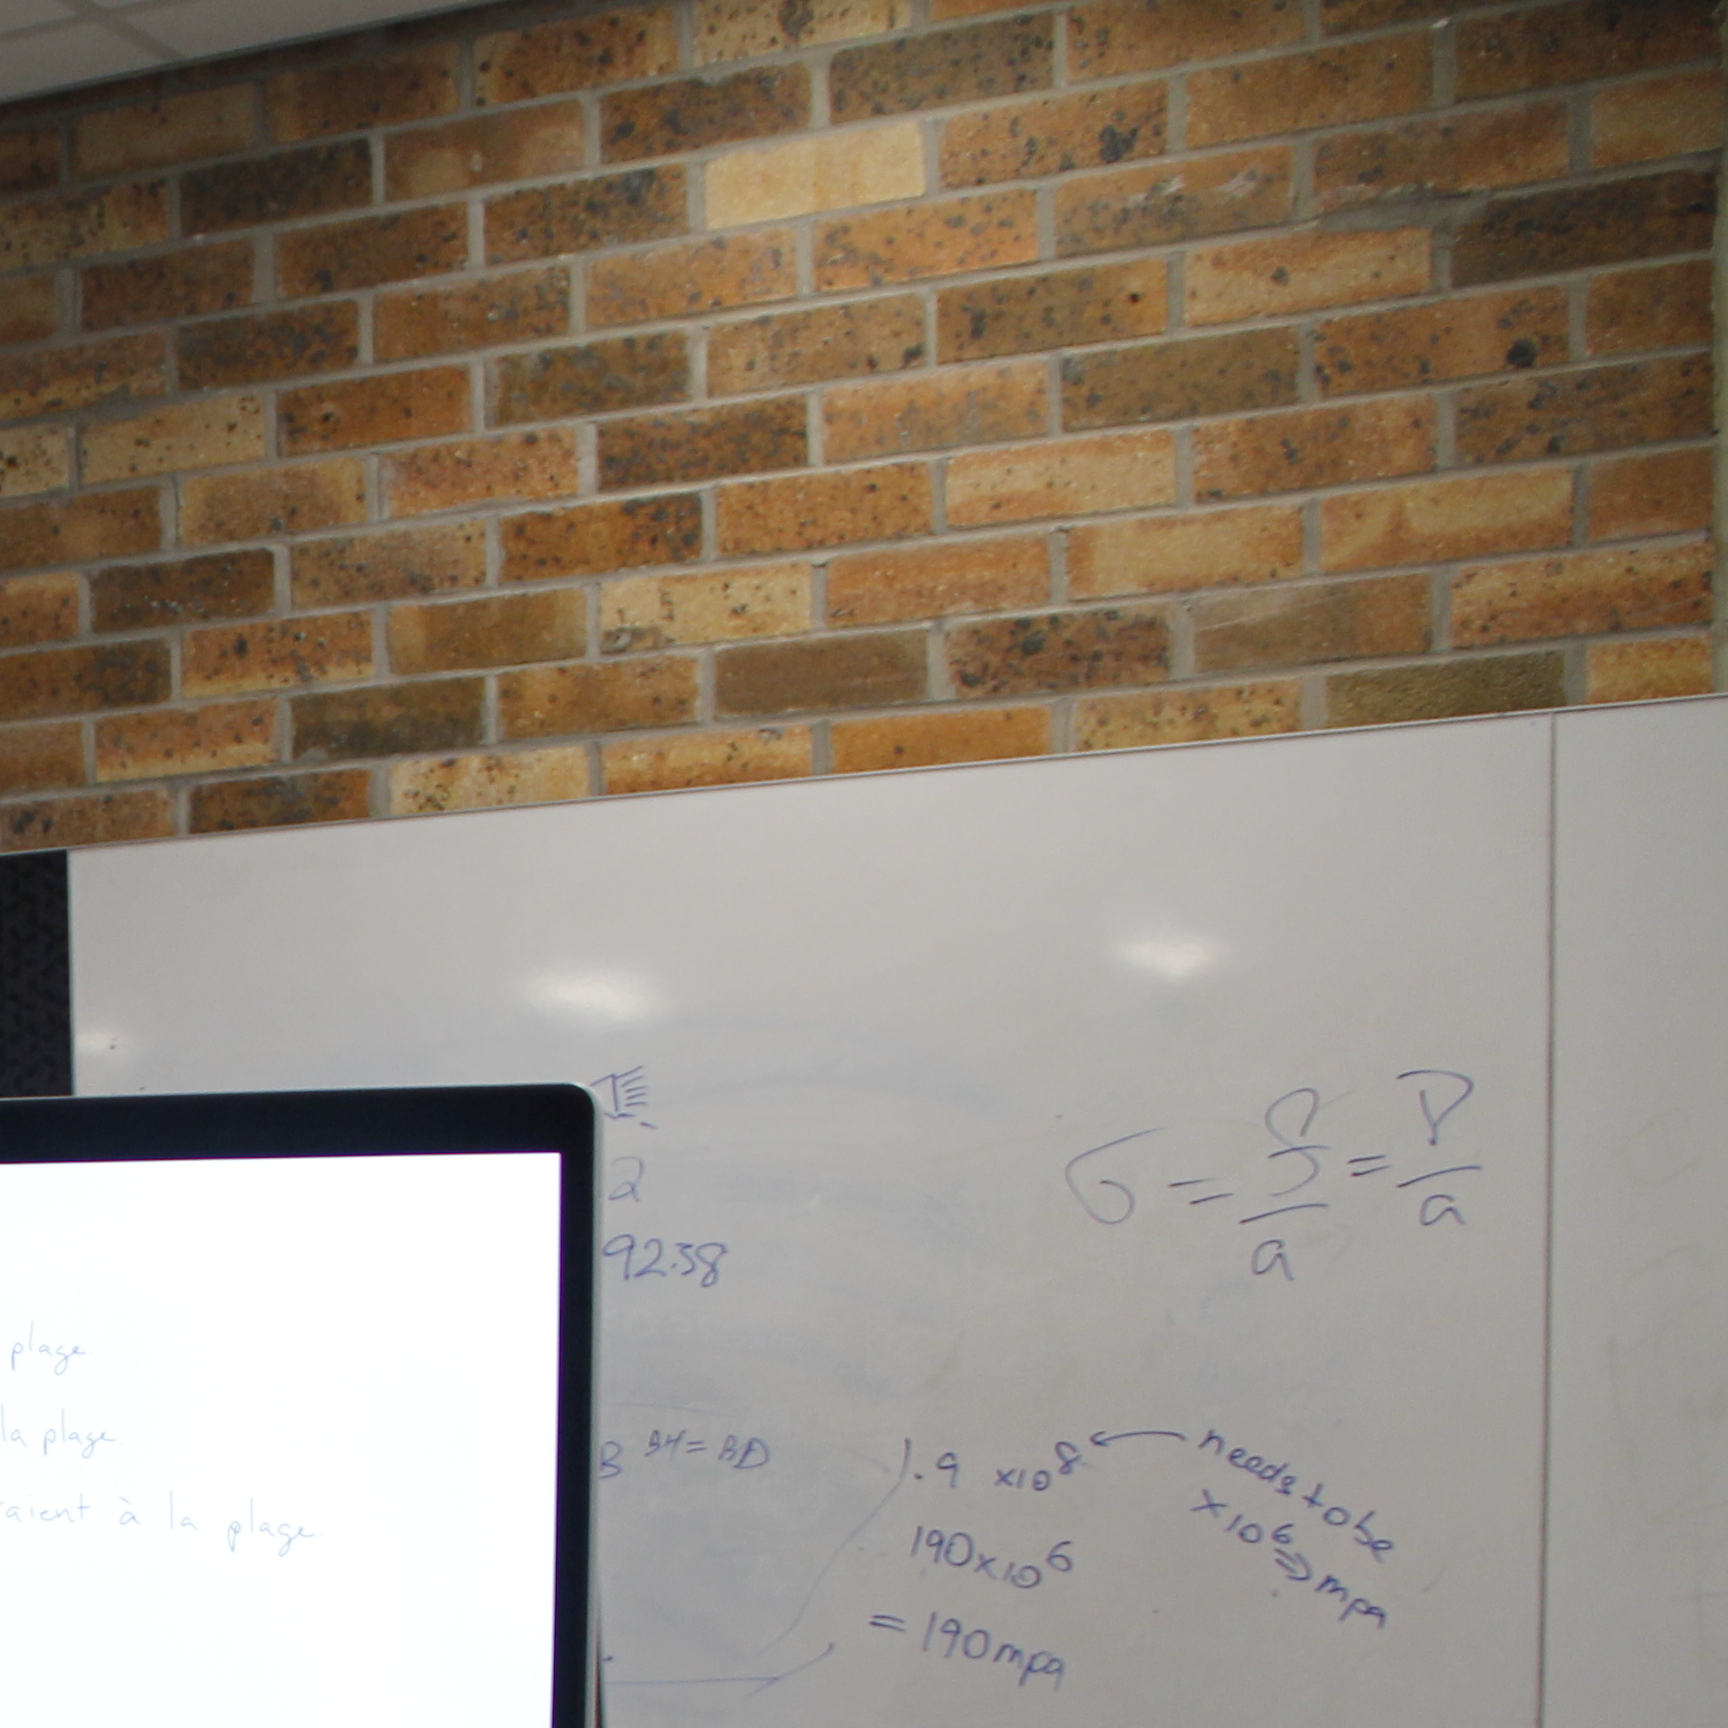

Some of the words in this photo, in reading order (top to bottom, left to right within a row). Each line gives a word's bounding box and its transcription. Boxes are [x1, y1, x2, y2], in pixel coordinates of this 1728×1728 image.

[0, 1402, 28, 1449] la
[118, 1495, 141, 1526] à
[169, 1489, 200, 1533] la
